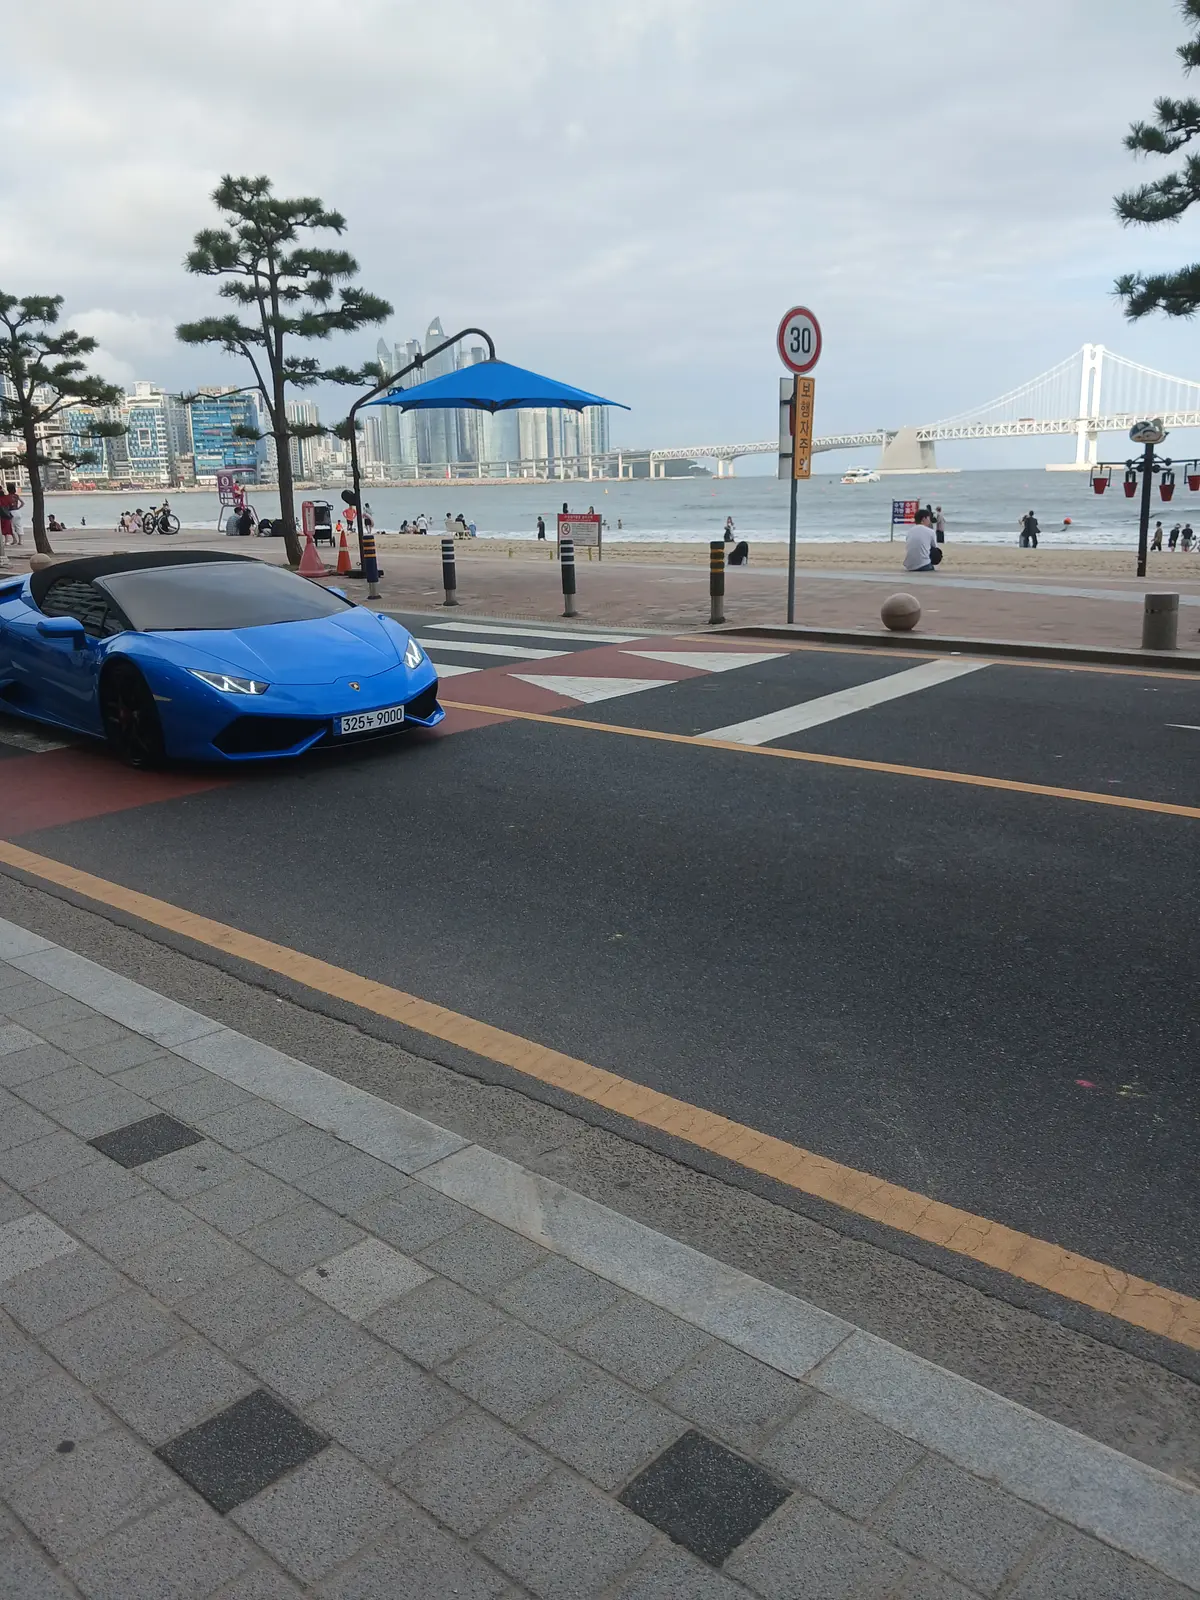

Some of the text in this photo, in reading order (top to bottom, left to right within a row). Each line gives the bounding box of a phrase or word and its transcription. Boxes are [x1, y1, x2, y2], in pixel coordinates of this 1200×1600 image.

[790, 327, 811, 354] 30
[343, 708, 402, 732] 325누 9000
